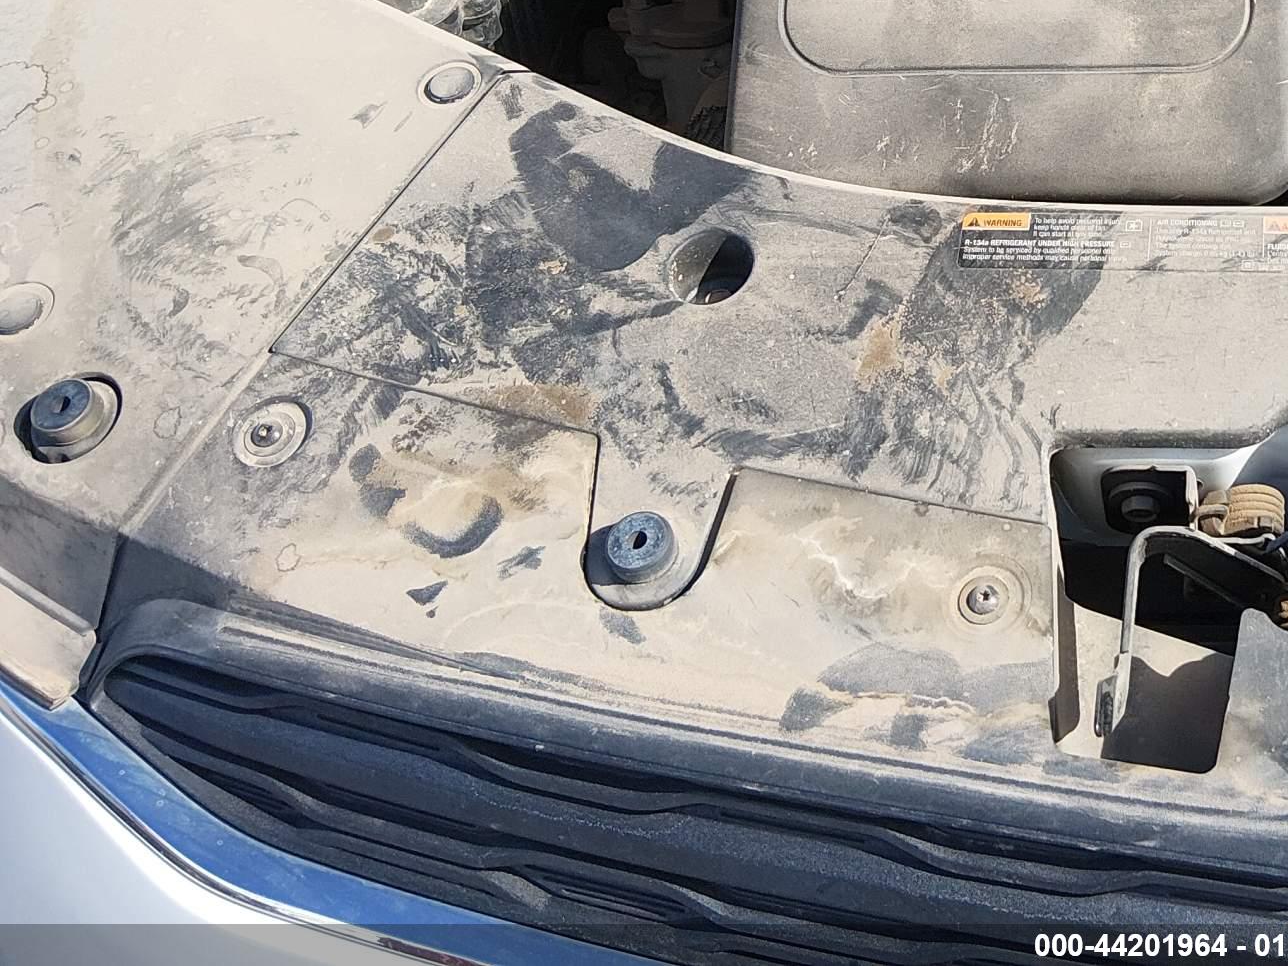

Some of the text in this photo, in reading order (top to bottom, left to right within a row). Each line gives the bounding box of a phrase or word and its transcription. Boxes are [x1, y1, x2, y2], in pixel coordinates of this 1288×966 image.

[983, 219, 1023, 227] WARNING
[1043, 217, 1057, 225] help
[1169, 219, 1218, 227] CONDITIONING
[963, 247, 987, 255] System
[1005, 247, 1033, 255] serviced
[1033, 247, 1042, 255] by
[1042, 247, 1070, 255] qualified
[1045, 255, 1058, 263] may
